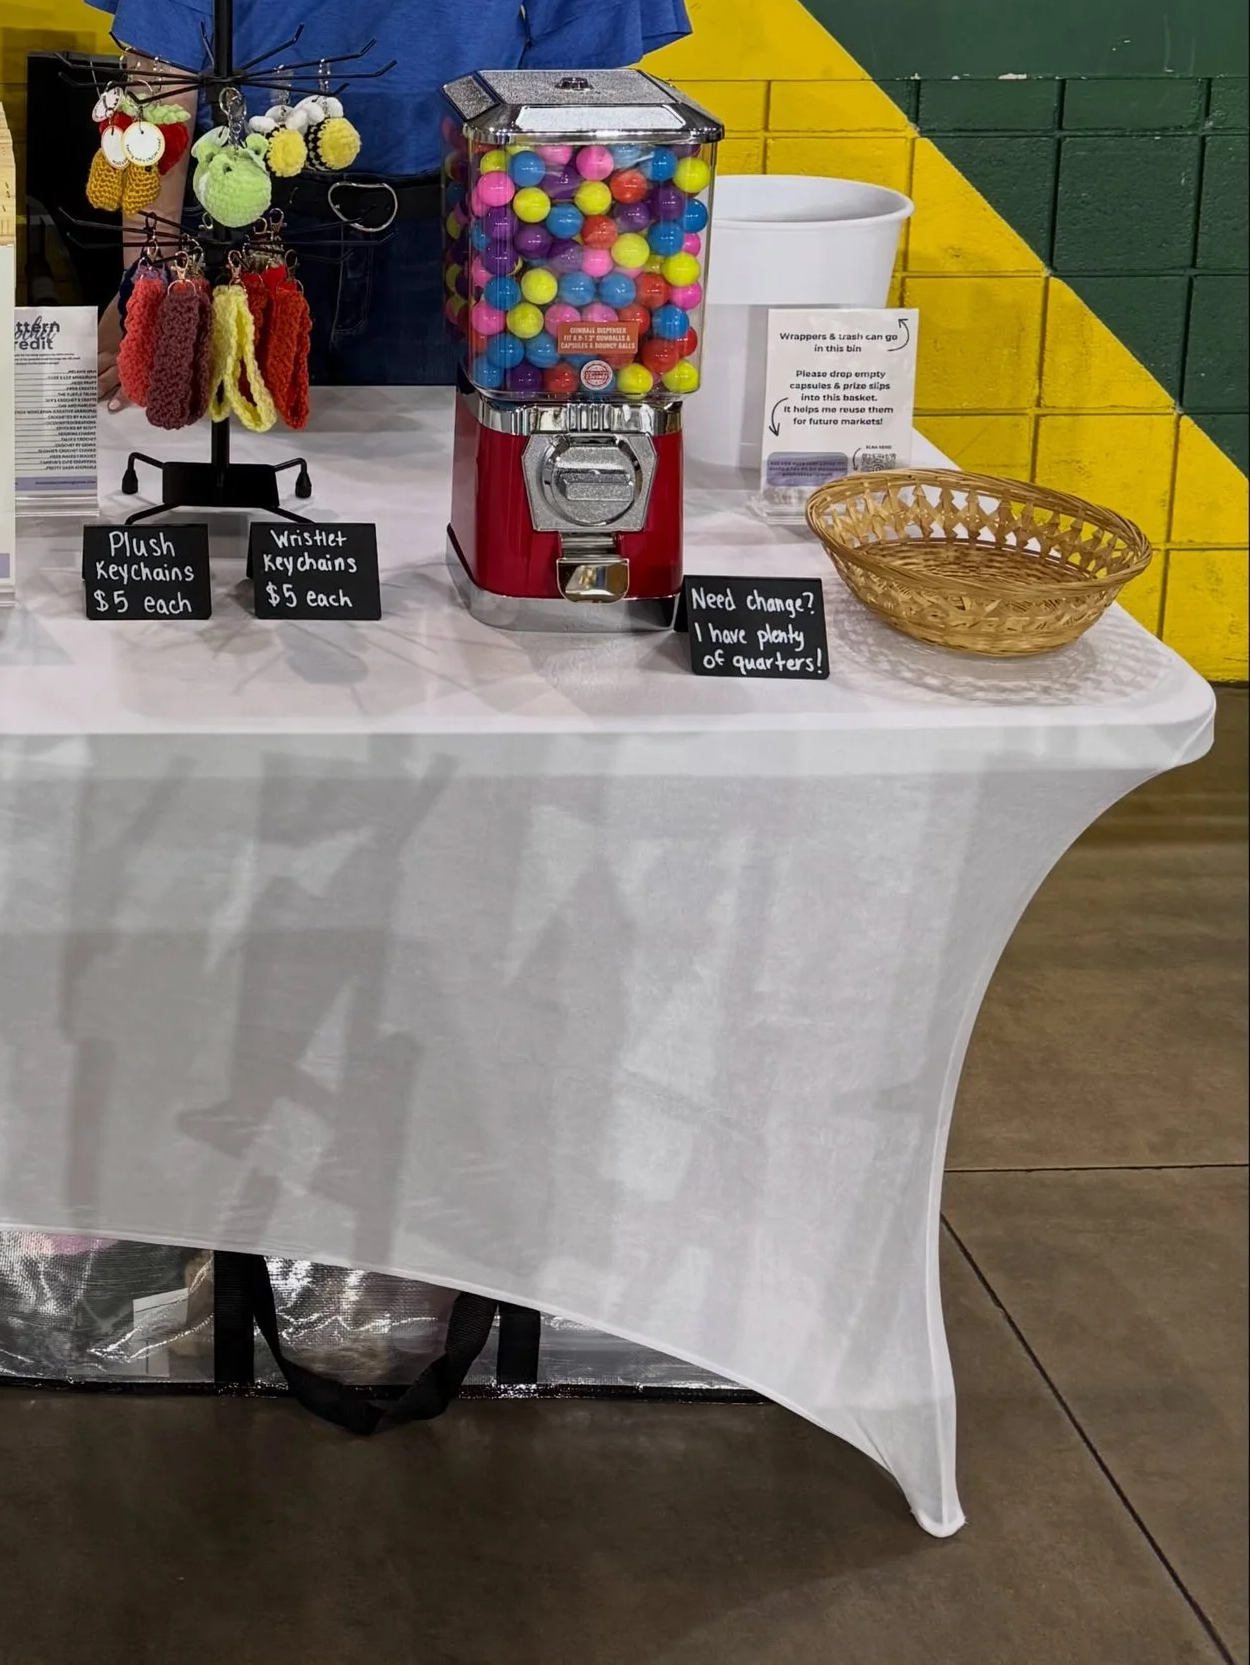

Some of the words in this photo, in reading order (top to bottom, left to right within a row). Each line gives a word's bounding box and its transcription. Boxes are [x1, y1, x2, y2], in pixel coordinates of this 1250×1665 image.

[16, 321, 60, 332] ttern
[780, 333, 826, 341] Wrappers
[885, 334, 898, 342] go
[814, 344, 823, 352] in
[796, 370, 827, 378] Please
[830, 370, 852, 379] drop
[855, 371, 886, 379] empty
[790, 382, 831, 390] capsules
[833, 382, 840, 390] &
[843, 382, 866, 390] prize
[869, 382, 890, 390] slips
[801, 393, 820, 401] into
[823, 393, 840, 401] this
[794, 406, 819, 414] helps
[793, 417, 806, 425] for
[809, 417, 839, 425] future
[108, 530, 176, 558] Plush
[270, 529, 348, 550] Wristlet
[96, 561, 194, 585] Keychains
[93, 589, 129, 613] $5
[144, 591, 192, 616] each
[265, 582, 298, 607] $5
[306, 588, 353, 608] each
[691, 587, 736, 611] Need
[746, 589, 815, 618] change?
[694, 622, 702, 642] I
[708, 623, 747, 644] have
[756, 623, 804, 651] plenty
[703, 649, 725, 668] of
[732, 648, 822, 675] quarters!
